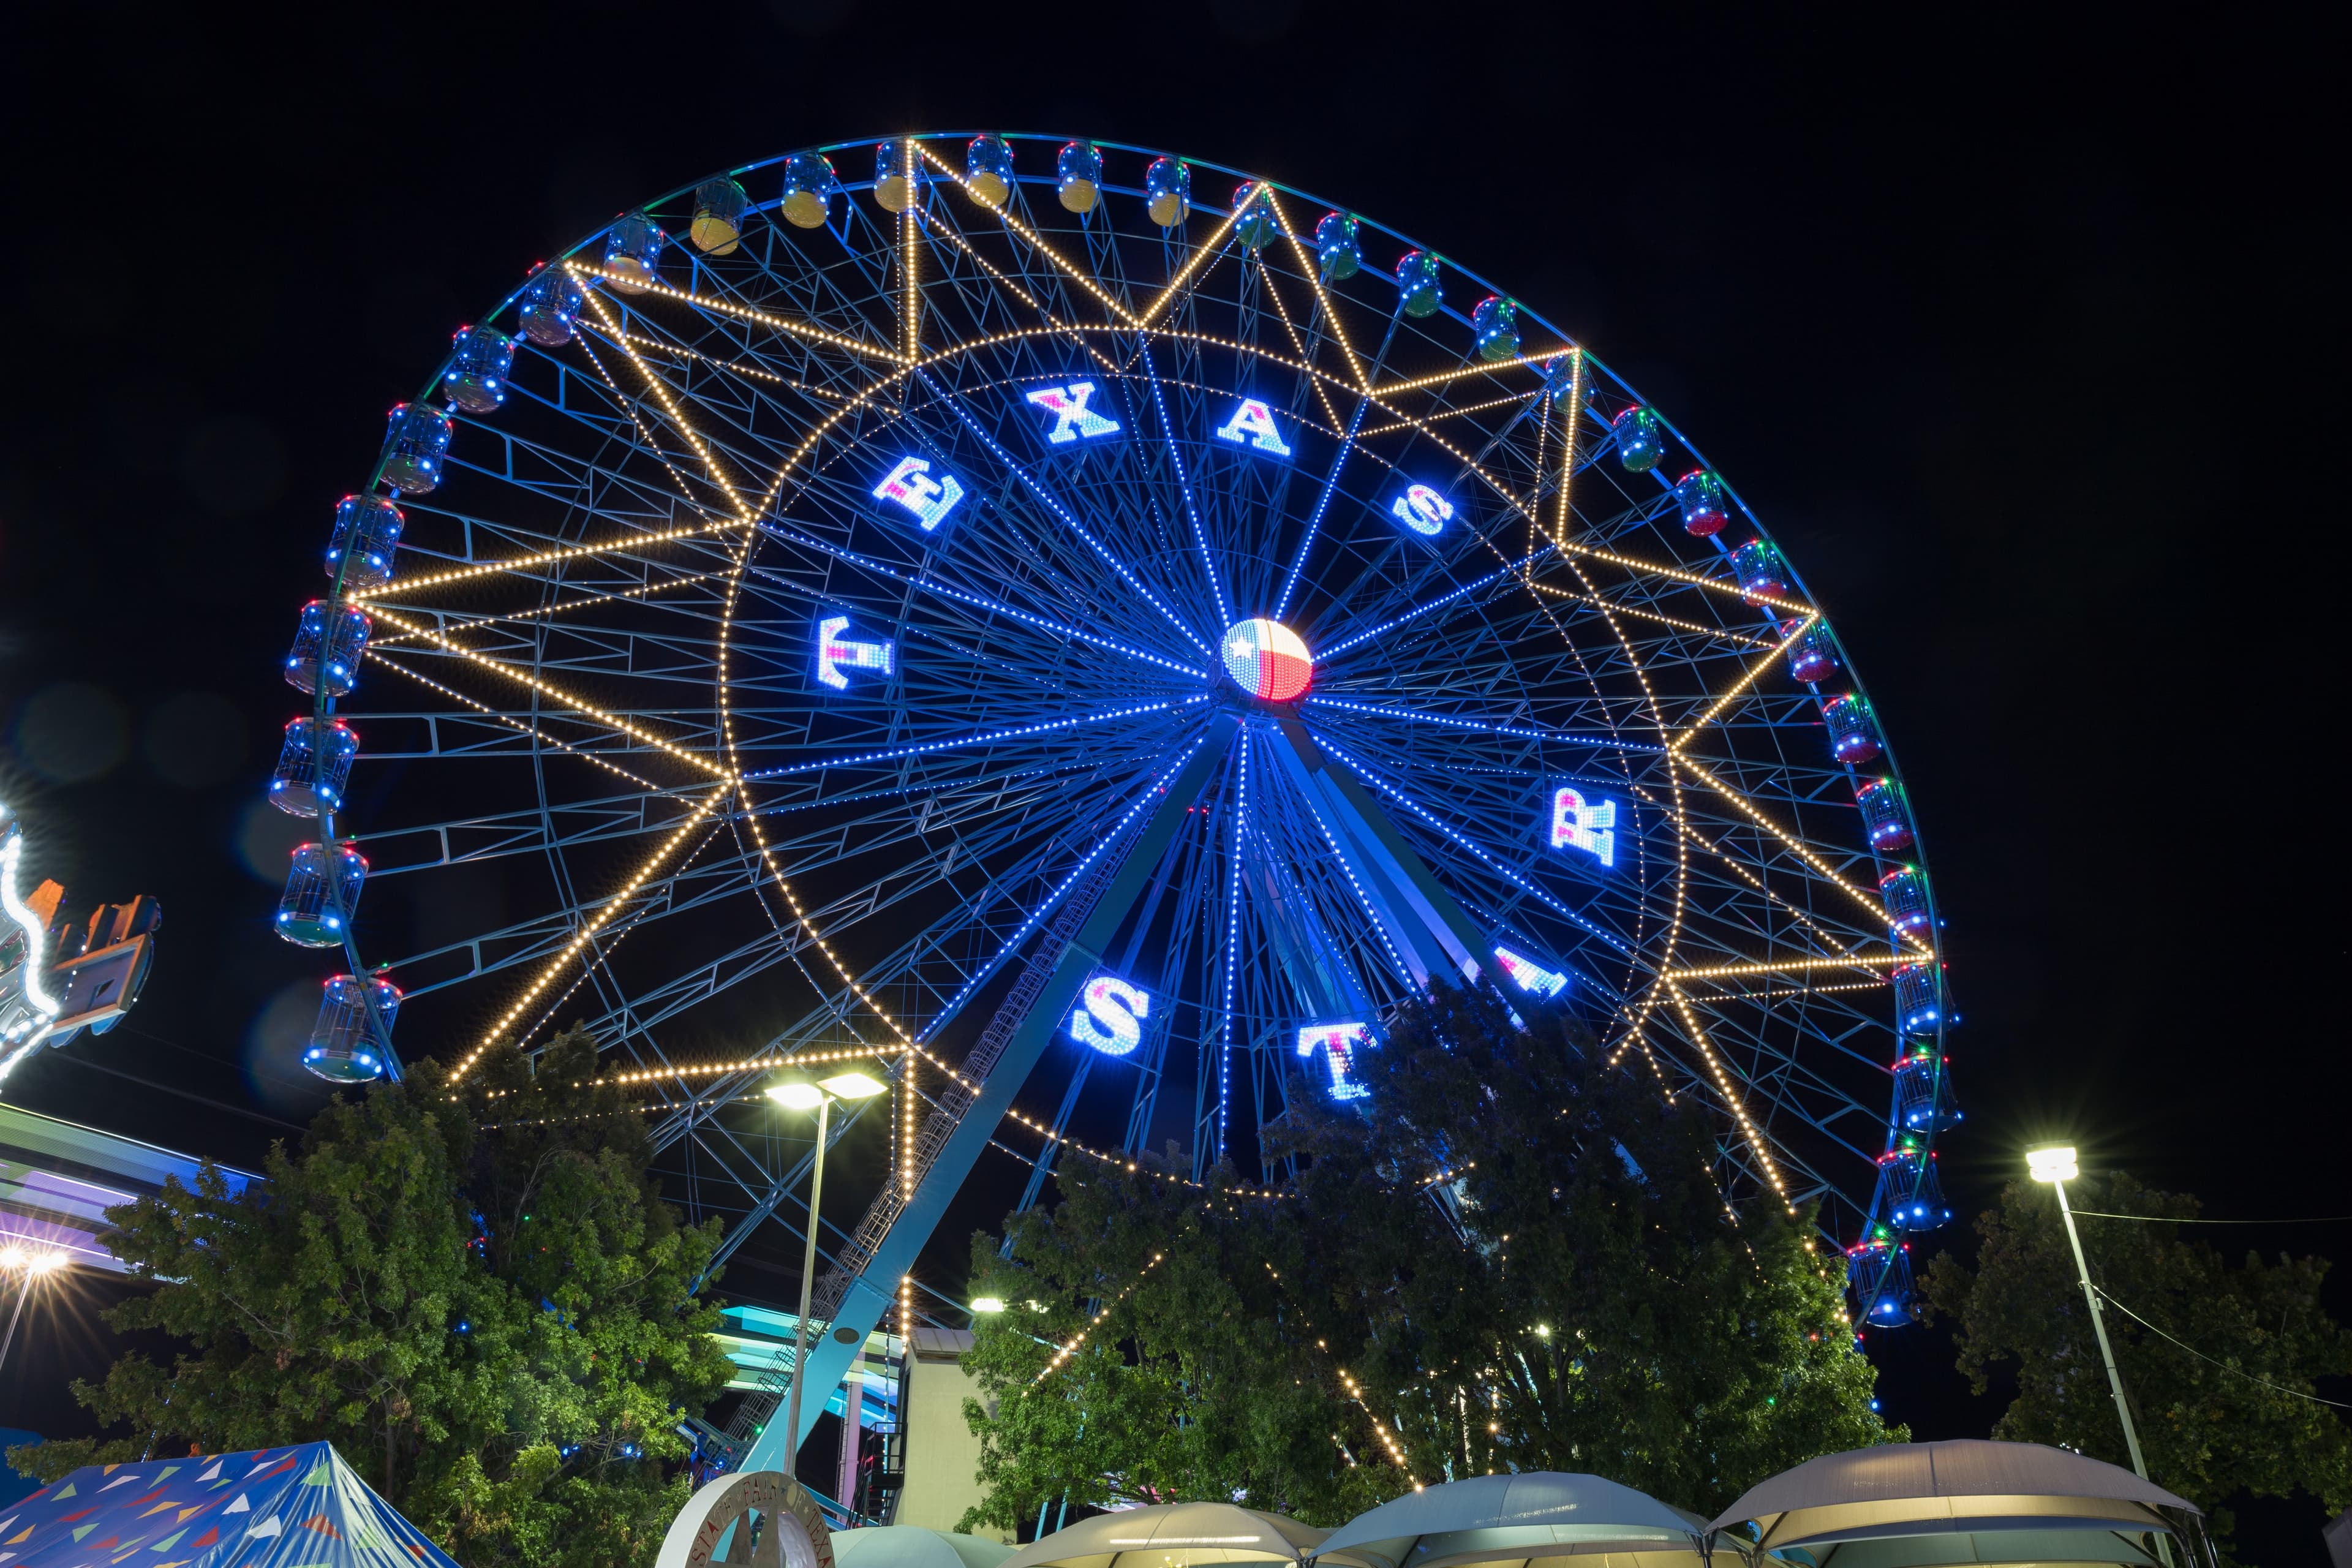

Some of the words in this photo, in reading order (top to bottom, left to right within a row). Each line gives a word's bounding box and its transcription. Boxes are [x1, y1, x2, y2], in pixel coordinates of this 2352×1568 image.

[818, 382, 1453, 690] TEXAS
[692, 1494, 734, 1567] STATE
[786, 1483, 807, 1512] OF
